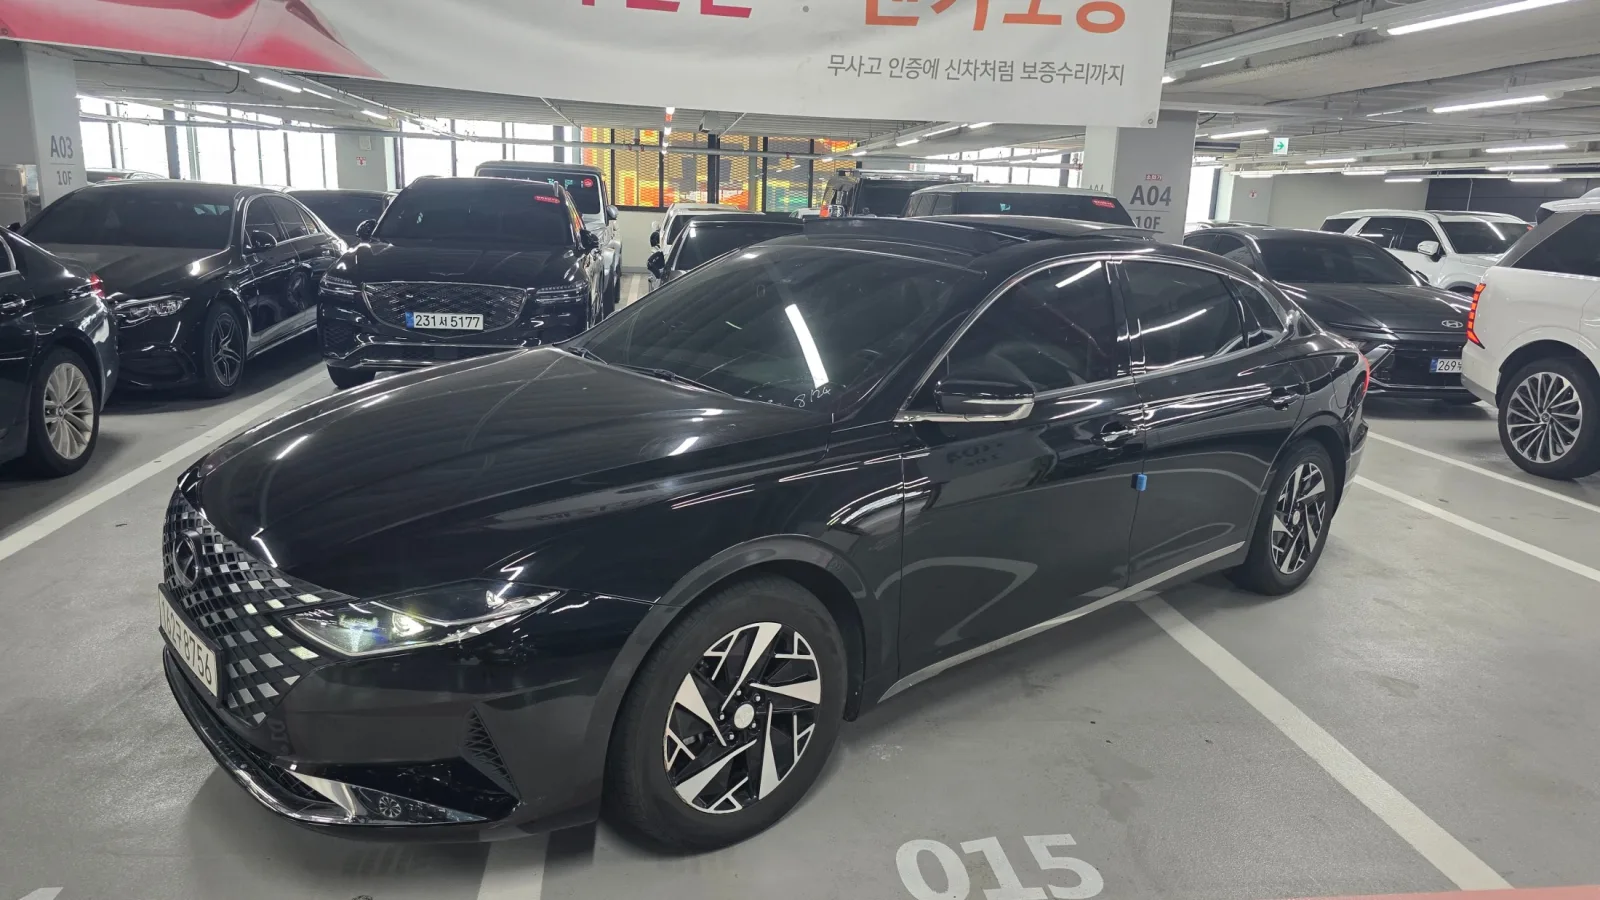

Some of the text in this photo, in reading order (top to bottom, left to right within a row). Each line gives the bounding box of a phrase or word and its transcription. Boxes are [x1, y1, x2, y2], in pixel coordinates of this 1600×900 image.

[827, 54, 1125, 86] 무사고 인증에 신차처럼 보증수리까지
[50, 135, 74, 159] A03
[56, 170, 72, 186] 10F
[1129, 184, 1172, 207] A04
[1135, 215, 1161, 230] 10F
[895, 833, 1104, 900] 015
